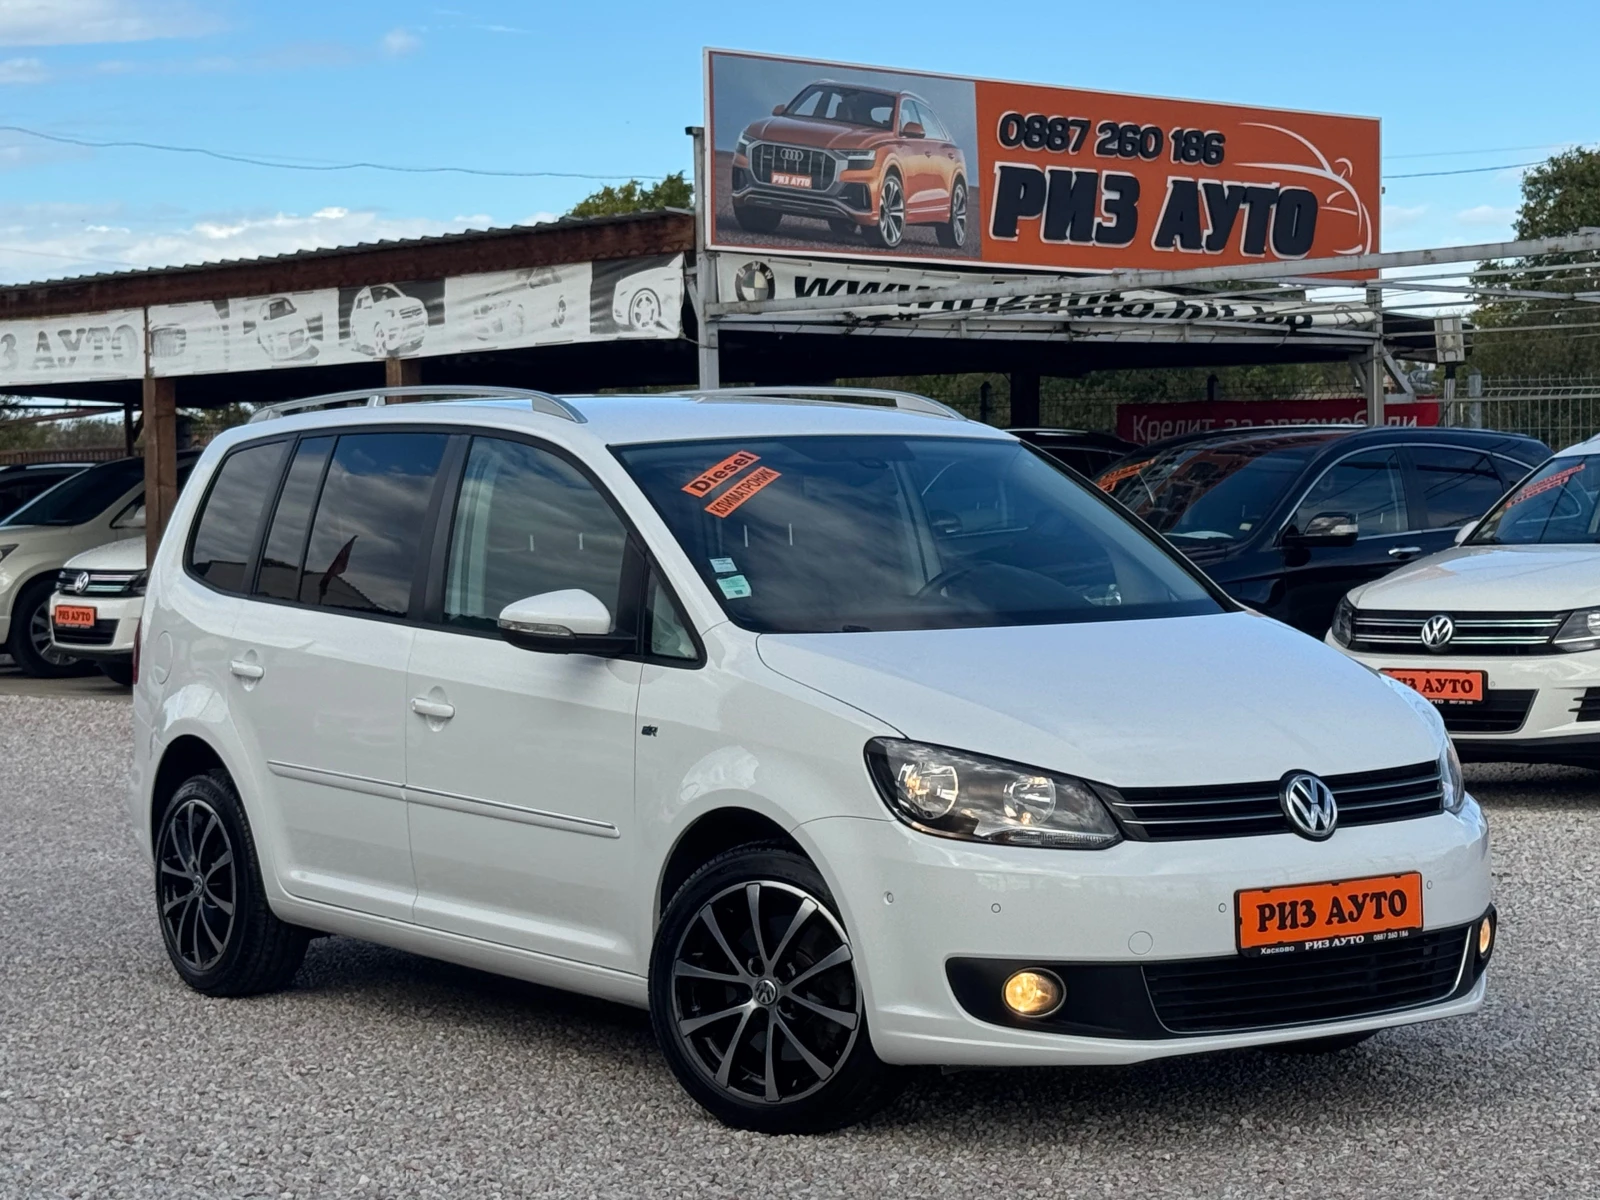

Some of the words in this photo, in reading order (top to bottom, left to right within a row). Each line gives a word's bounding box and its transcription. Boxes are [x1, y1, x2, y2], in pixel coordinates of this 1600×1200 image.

[998, 110, 1091, 154] 0887
[1095, 120, 1164, 161] 260
[1170, 127, 1226, 165] 186
[989, 161, 1140, 248] РИЗ
[1151, 176, 1318, 259] АУТО
[690, 454, 755, 492] Diesel
[711, 469, 775, 515] КЛИМАТРОНИК
[71, 611, 91, 622] АУТО
[1422, 678, 1474, 694] АУТО
[1256, 899, 1317, 932] РИЗ
[1324, 889, 1408, 926] АУТО
[1260, 945, 1295, 955] Хасково
[1304, 939, 1330, 950] РИЗ
[1331, 935, 1365, 947] АУТО
